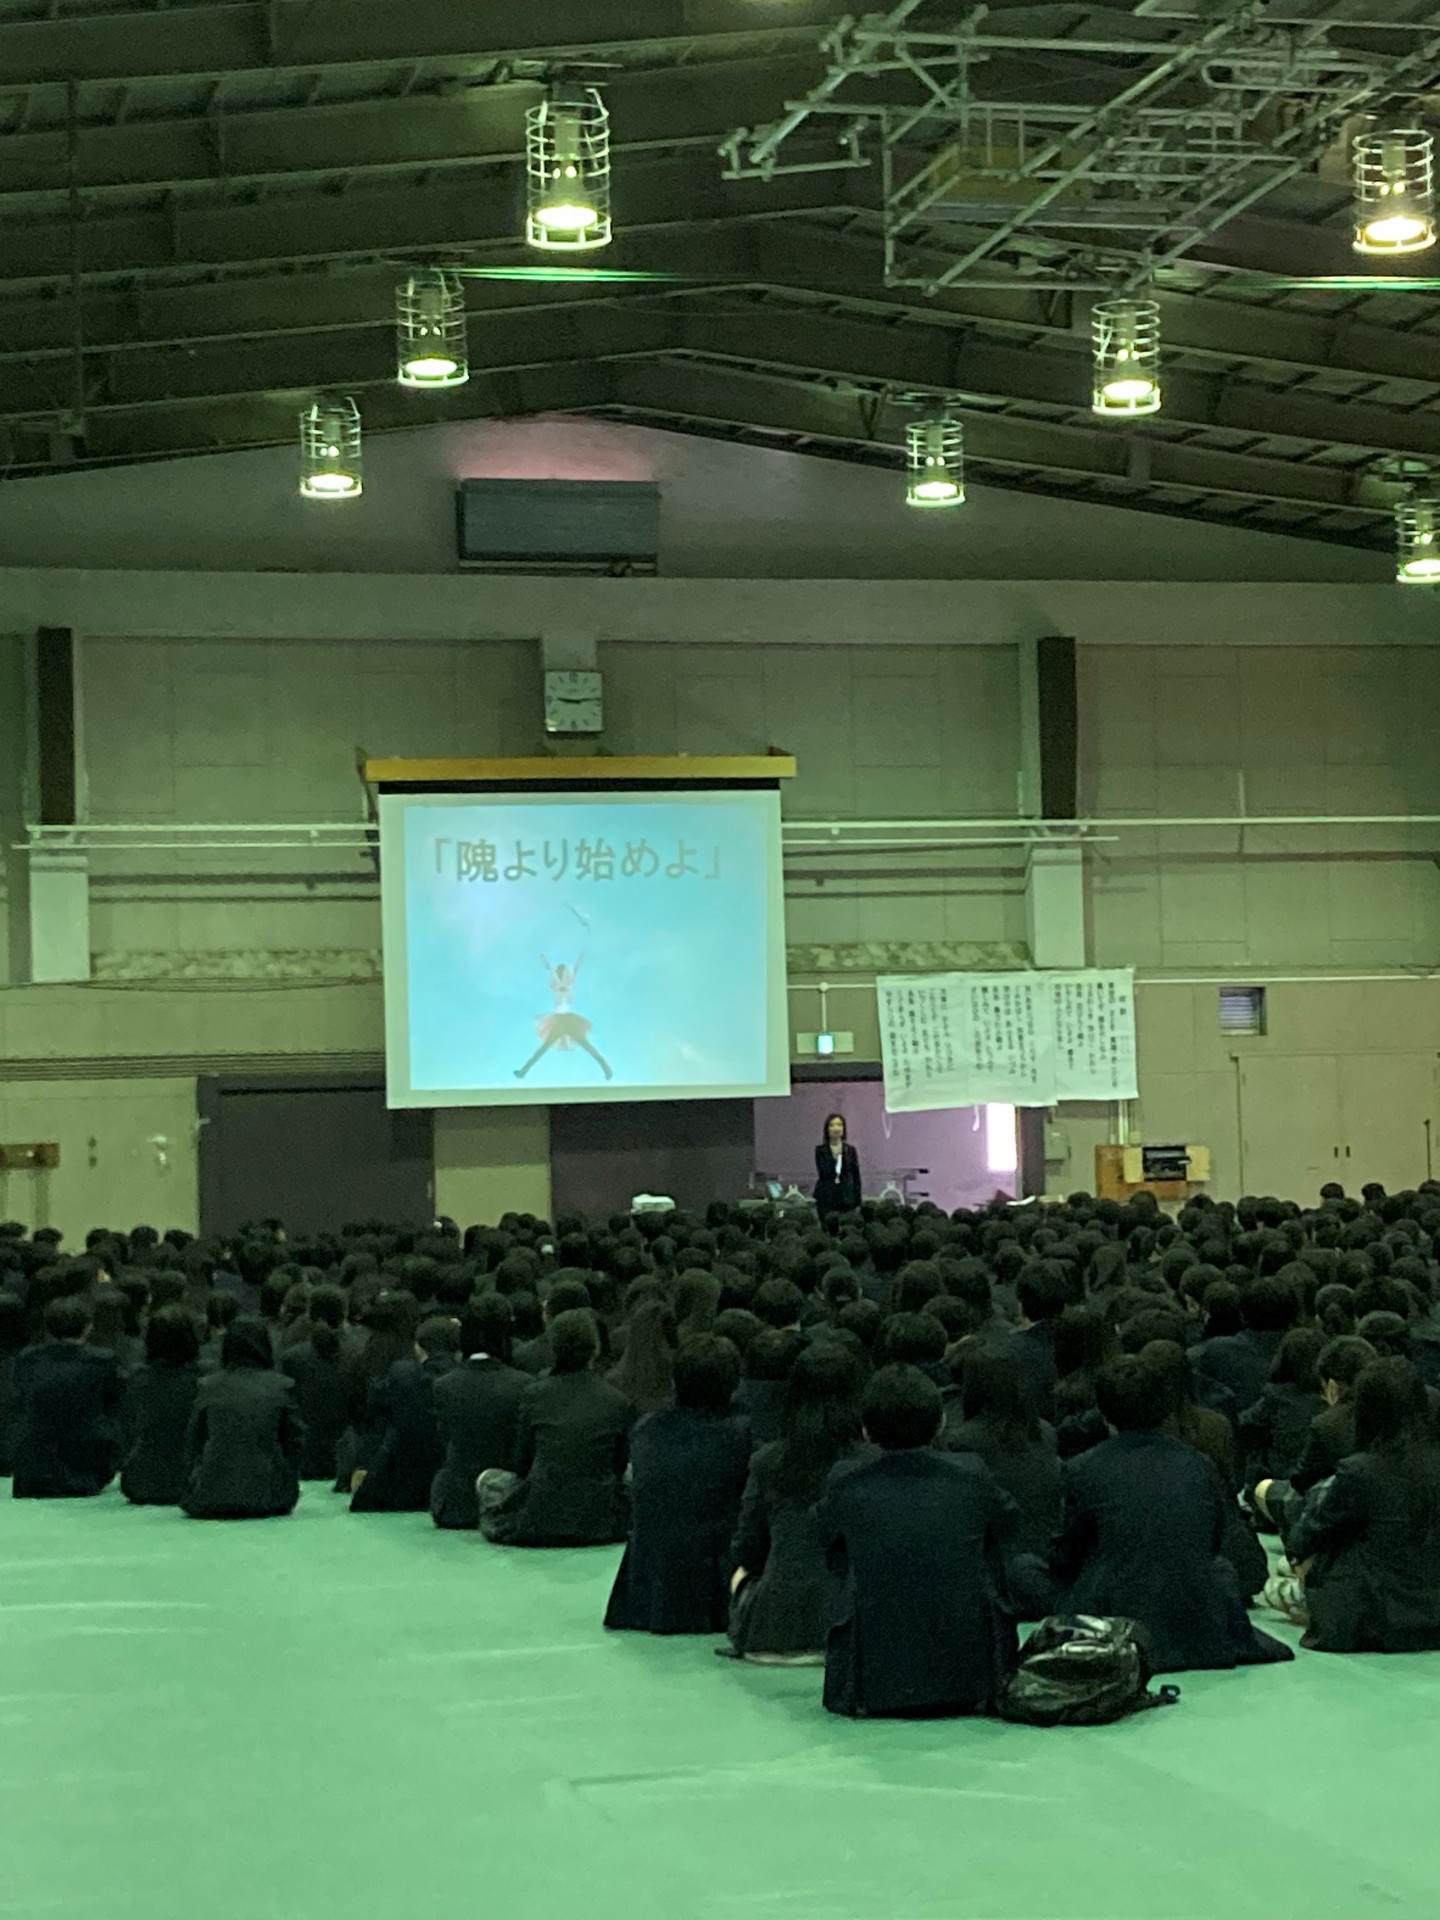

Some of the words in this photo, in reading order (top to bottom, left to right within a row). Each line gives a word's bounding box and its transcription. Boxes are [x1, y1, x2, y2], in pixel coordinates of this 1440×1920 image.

[434, 837, 721, 882] 「隗より始めよ」
